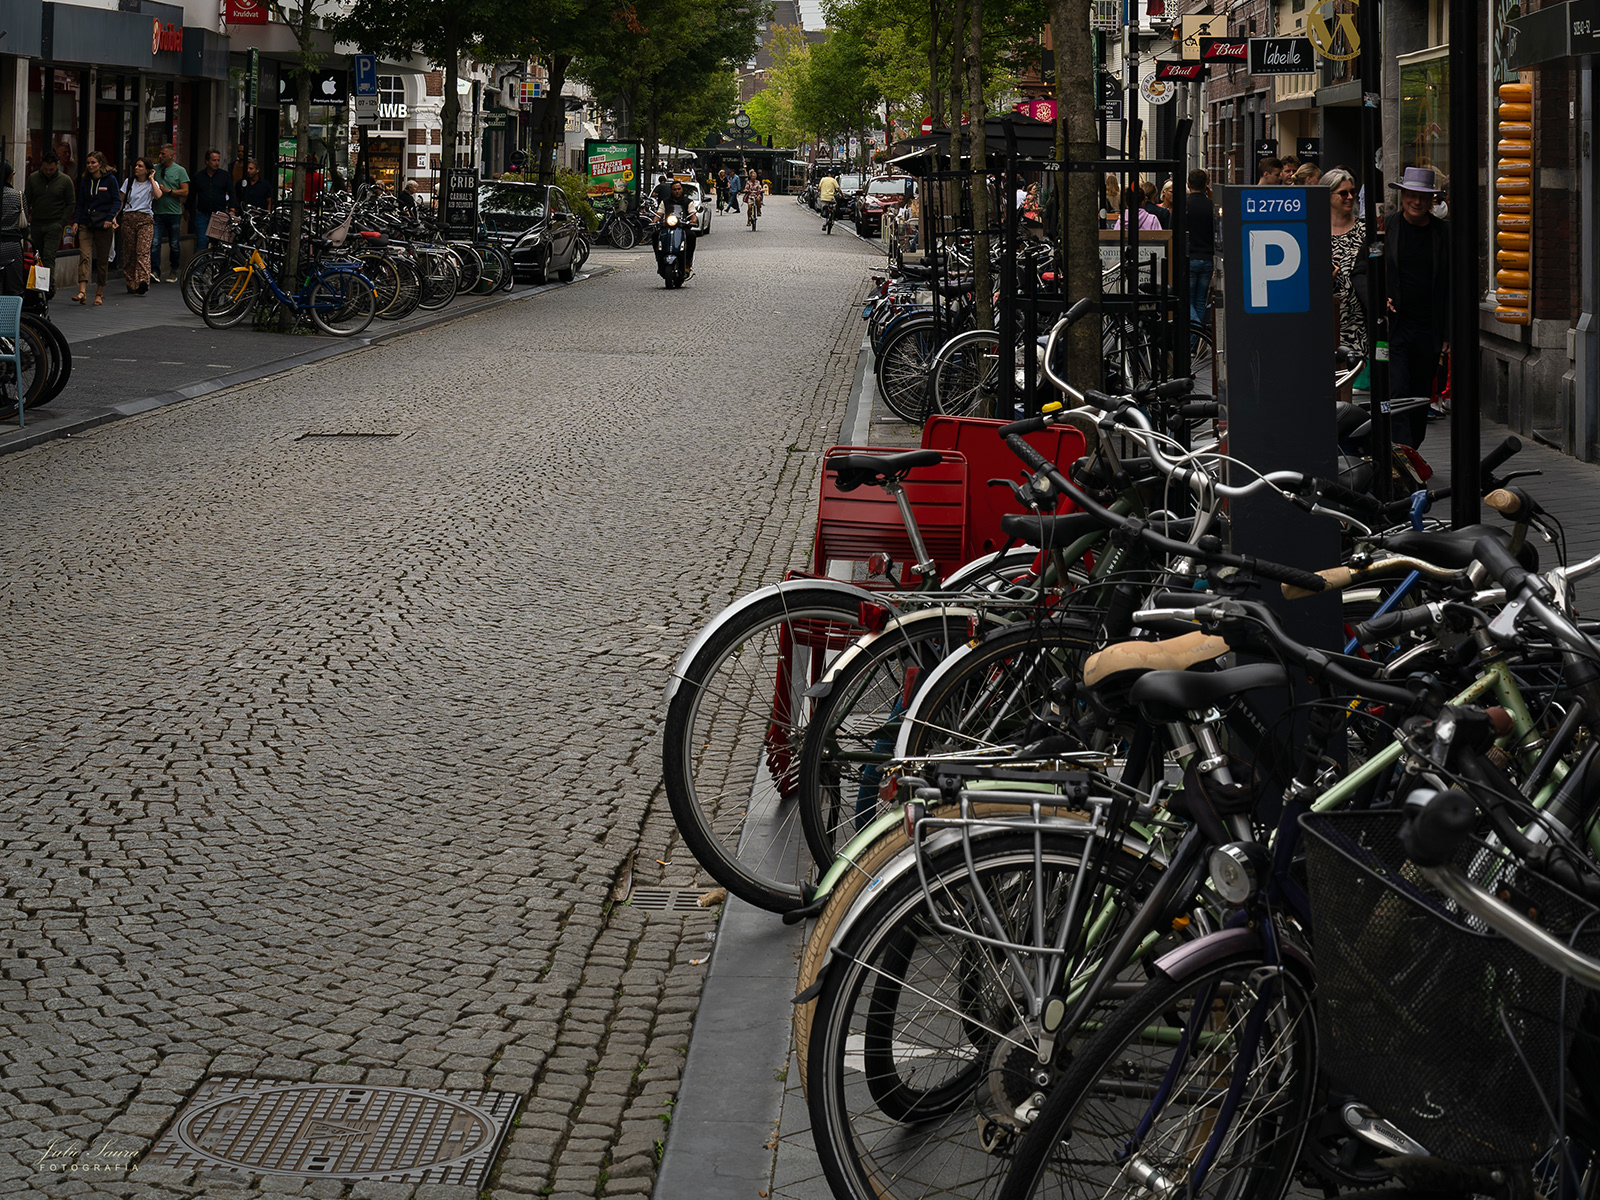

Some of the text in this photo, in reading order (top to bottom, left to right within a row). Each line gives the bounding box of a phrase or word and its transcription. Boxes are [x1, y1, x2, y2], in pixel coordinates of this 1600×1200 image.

[232, 10, 259, 18] Kruidvat
[1213, 43, 1245, 56] Bud
[1263, 40, 1301, 65] l'abeille
[360, 58, 371, 79] P
[1166, 65, 1193, 76] Bud
[1145, 93, 1170, 103] BEANS
[378, 103, 408, 118] NWB
[450, 176, 475, 189] CRIB
[1258, 199, 1301, 213] 27769
[1249, 229, 1301, 308] P
[1374, 1124, 1406, 1145] SHIMANO
